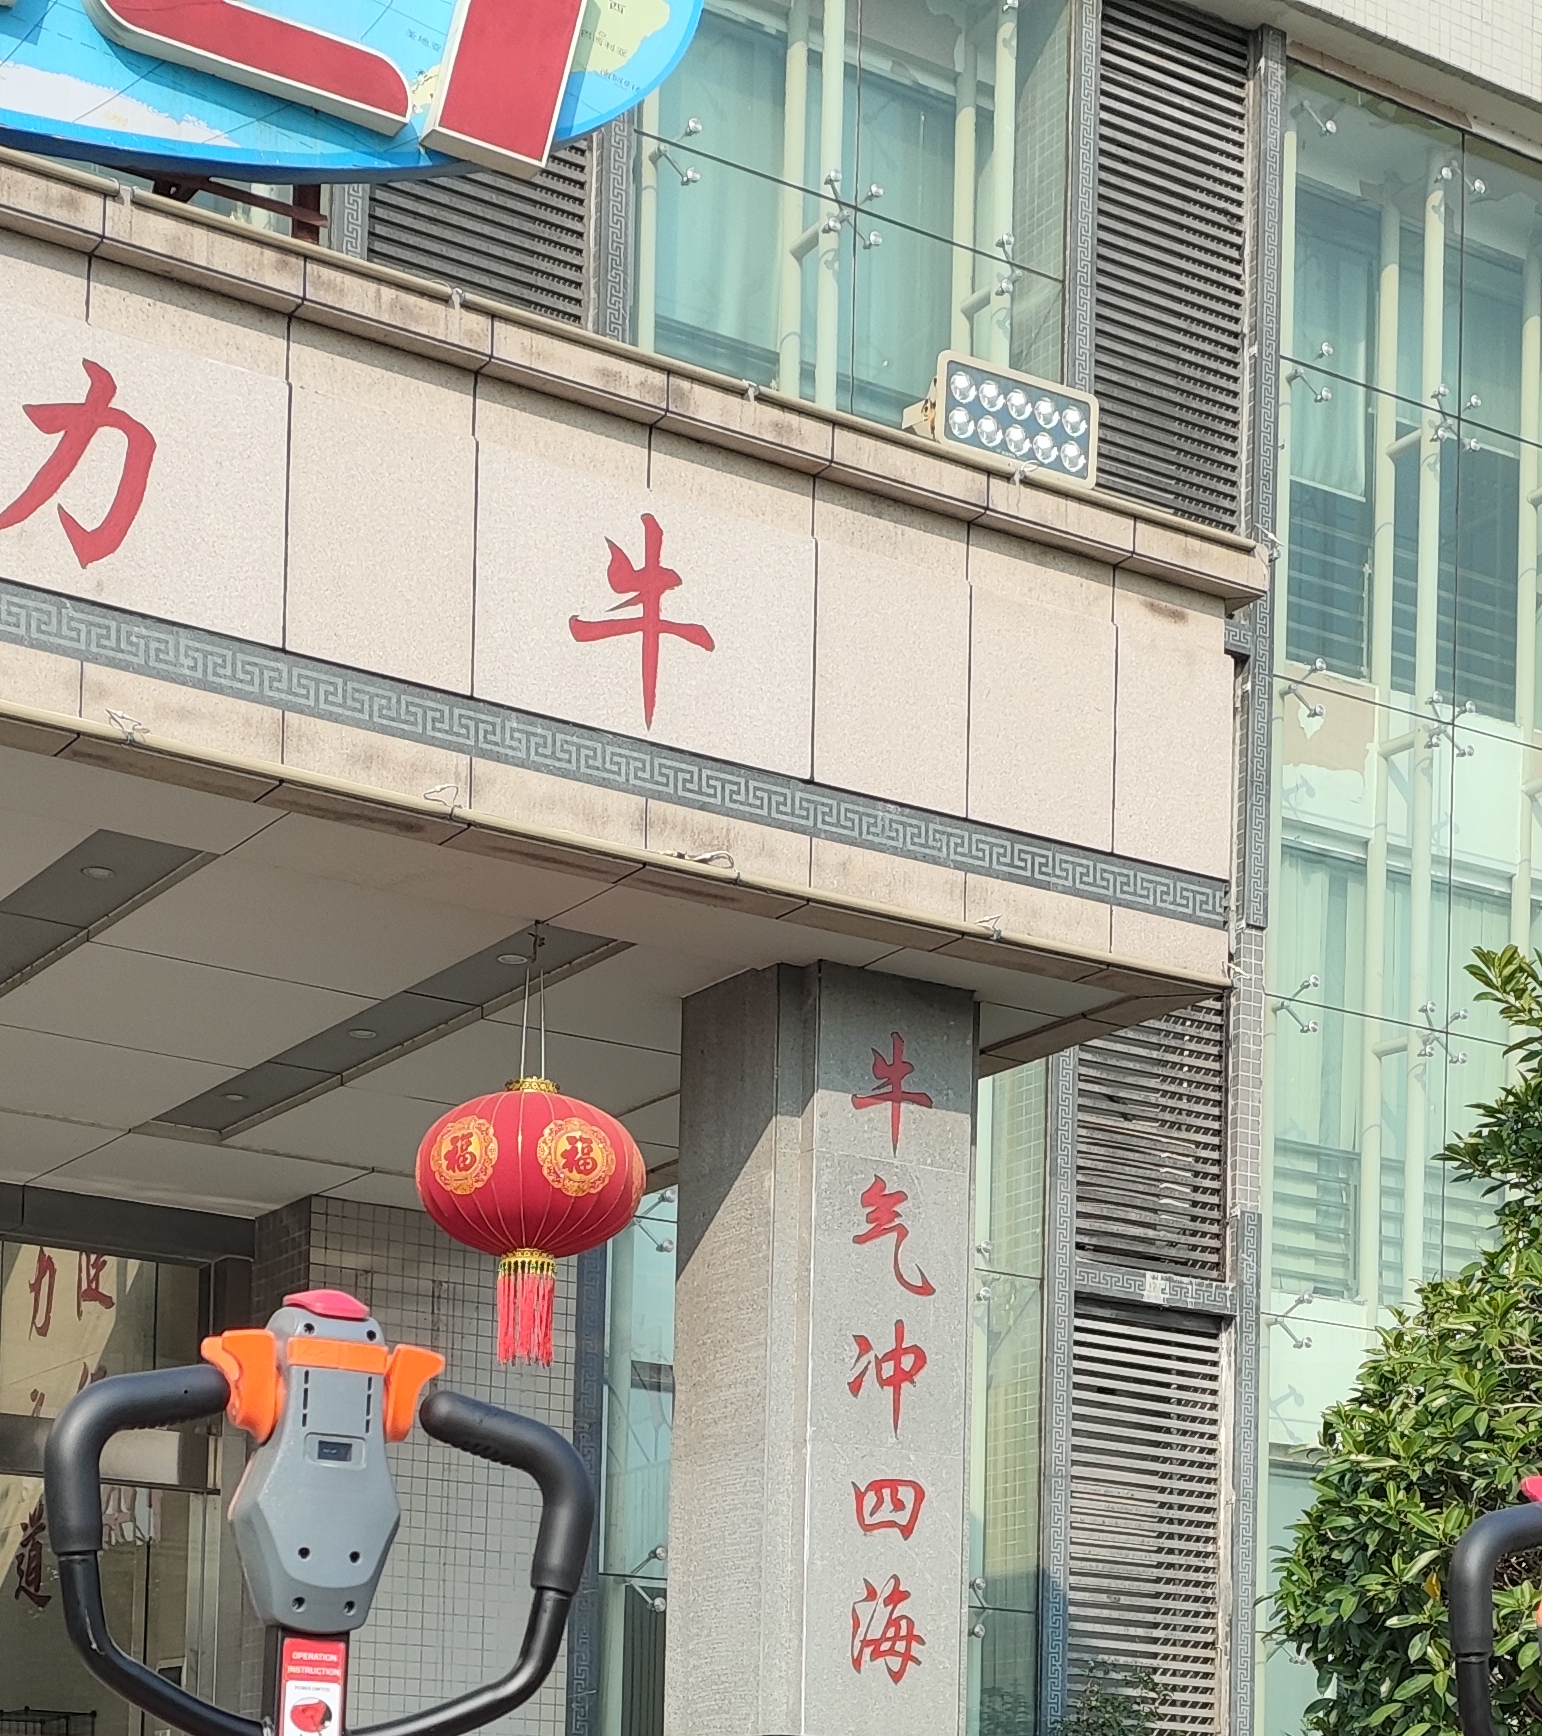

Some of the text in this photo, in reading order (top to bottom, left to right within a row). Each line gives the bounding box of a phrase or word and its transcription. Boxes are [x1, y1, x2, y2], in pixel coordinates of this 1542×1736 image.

[443, 1132, 477, 1174] 福
[560, 1135, 598, 1176] 福
[291, 1651, 338, 1662] OPERATION
[287, 1665, 342, 1677] INSTRUCTION
